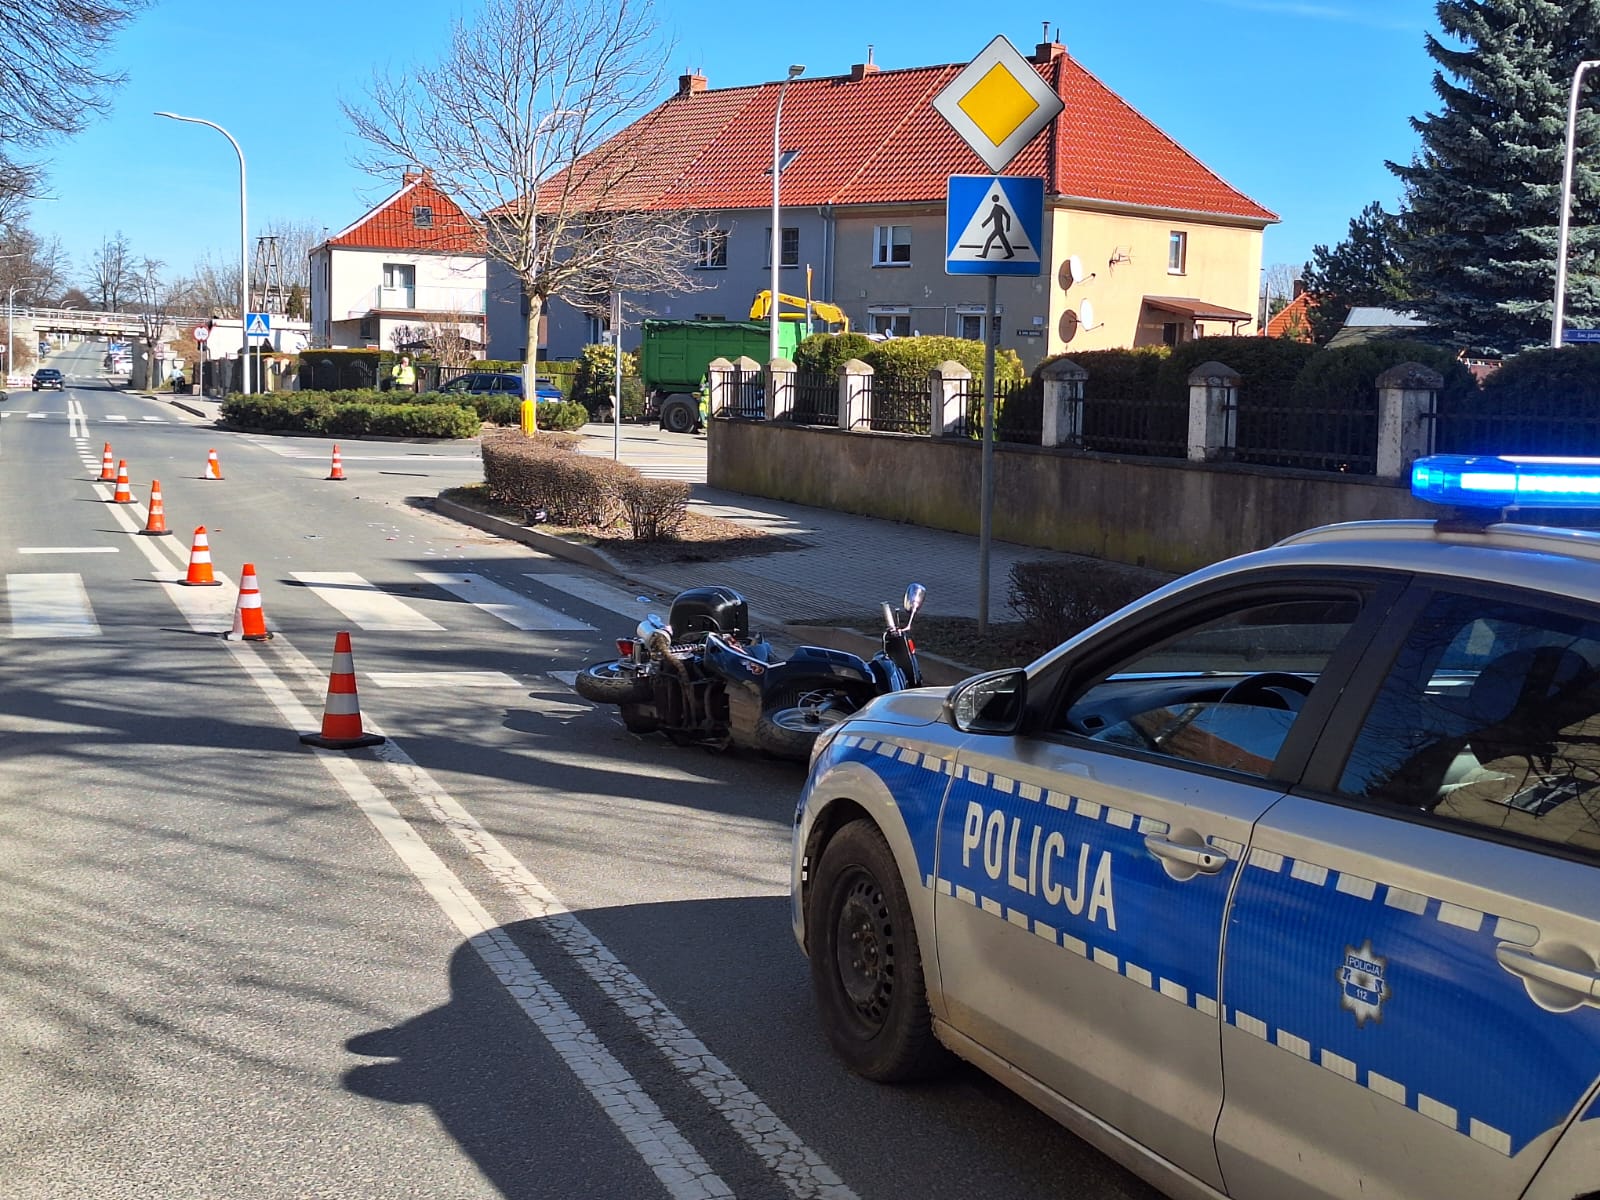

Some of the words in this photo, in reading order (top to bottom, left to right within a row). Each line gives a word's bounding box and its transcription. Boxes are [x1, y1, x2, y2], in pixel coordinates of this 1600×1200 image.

[963, 801, 1116, 931] POLICJA
[1349, 957, 1380, 976] POLICJA
[1356, 989, 1367, 1000] 112
